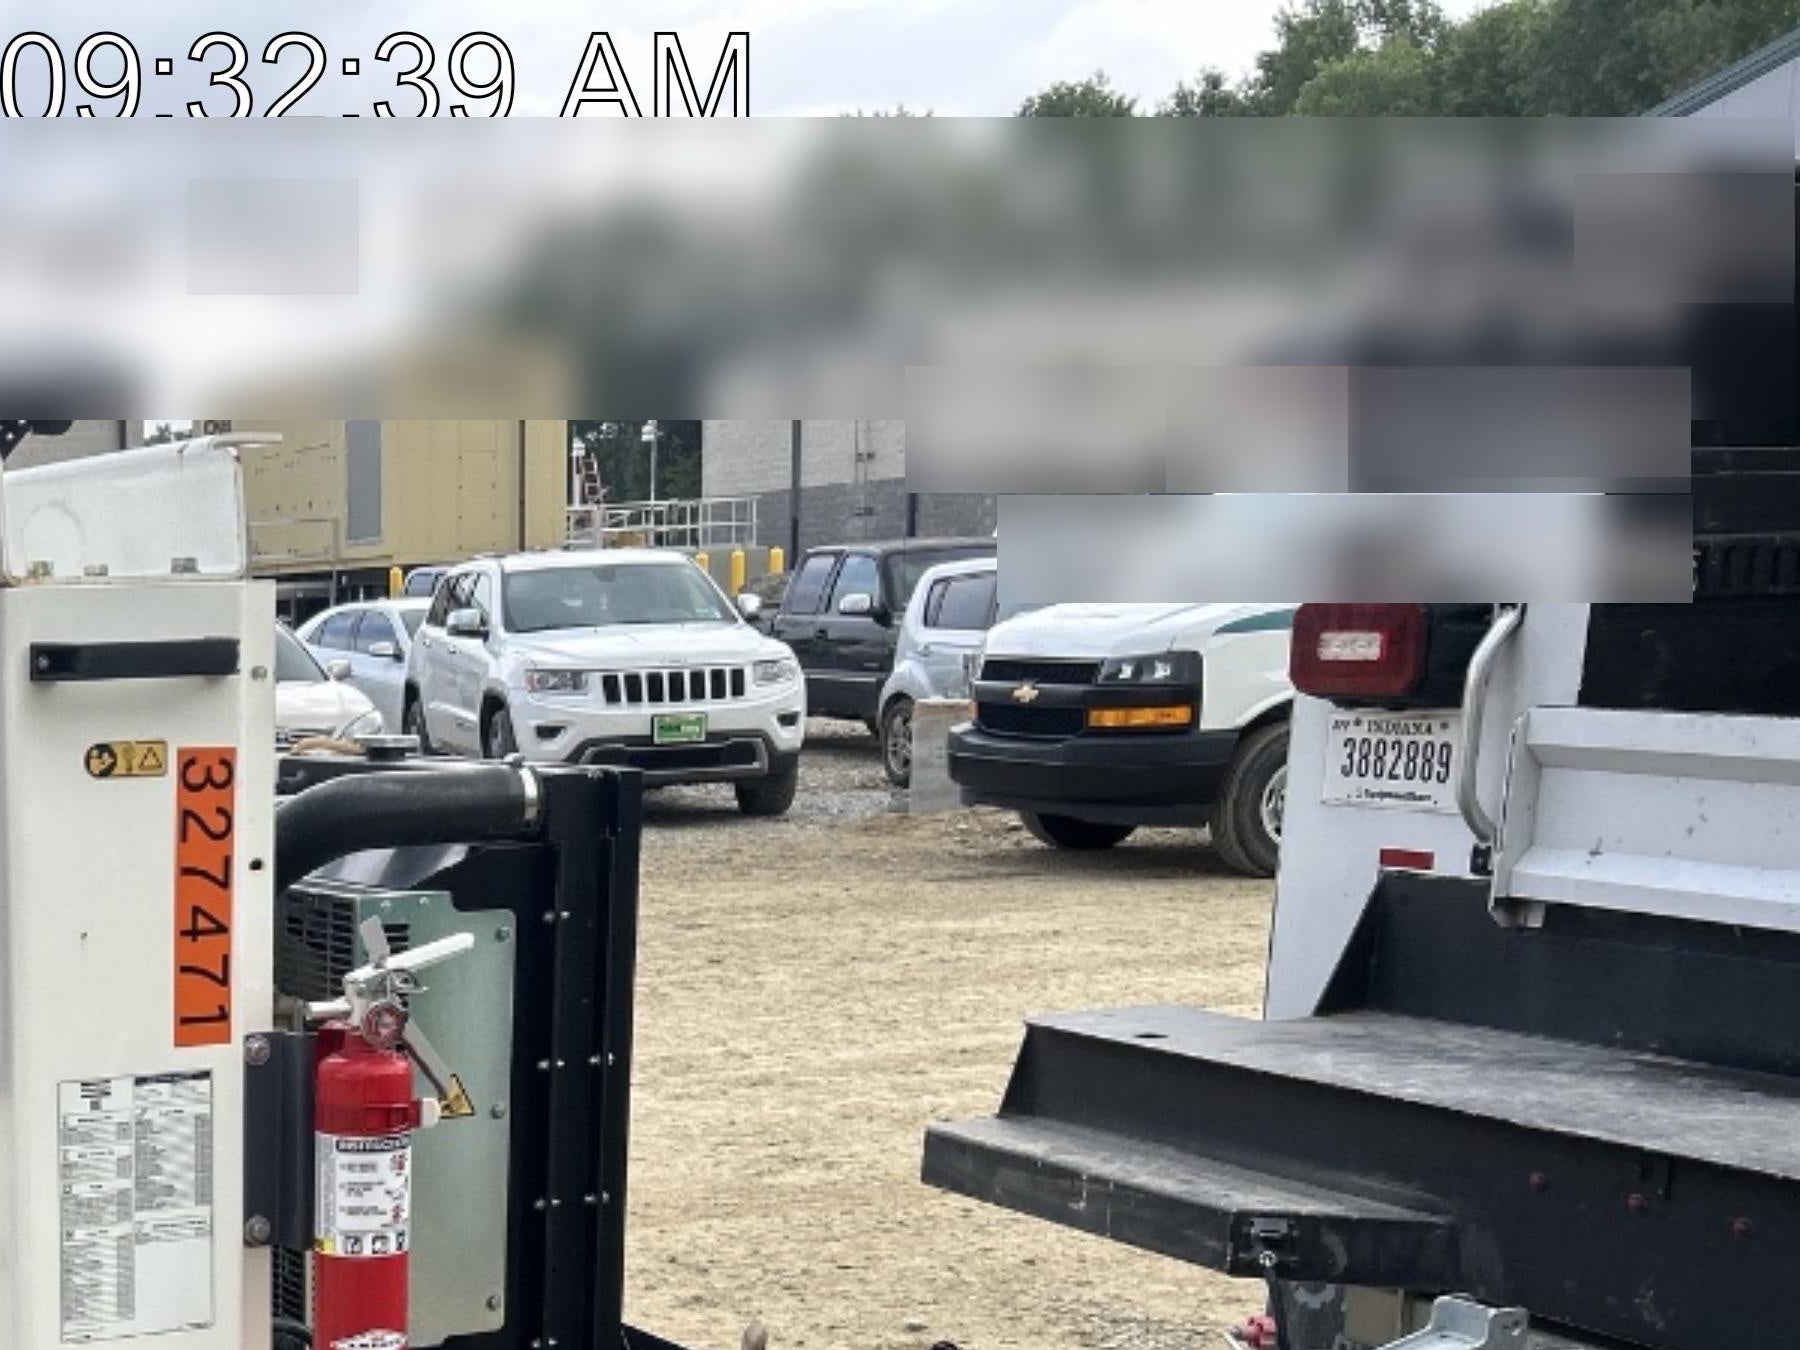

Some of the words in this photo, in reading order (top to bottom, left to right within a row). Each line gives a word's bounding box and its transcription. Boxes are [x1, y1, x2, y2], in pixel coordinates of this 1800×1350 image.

[1367, 719, 1433, 735] INDIANA
[1340, 737, 1453, 784] 3882889
[179, 757, 234, 1026] 327471
